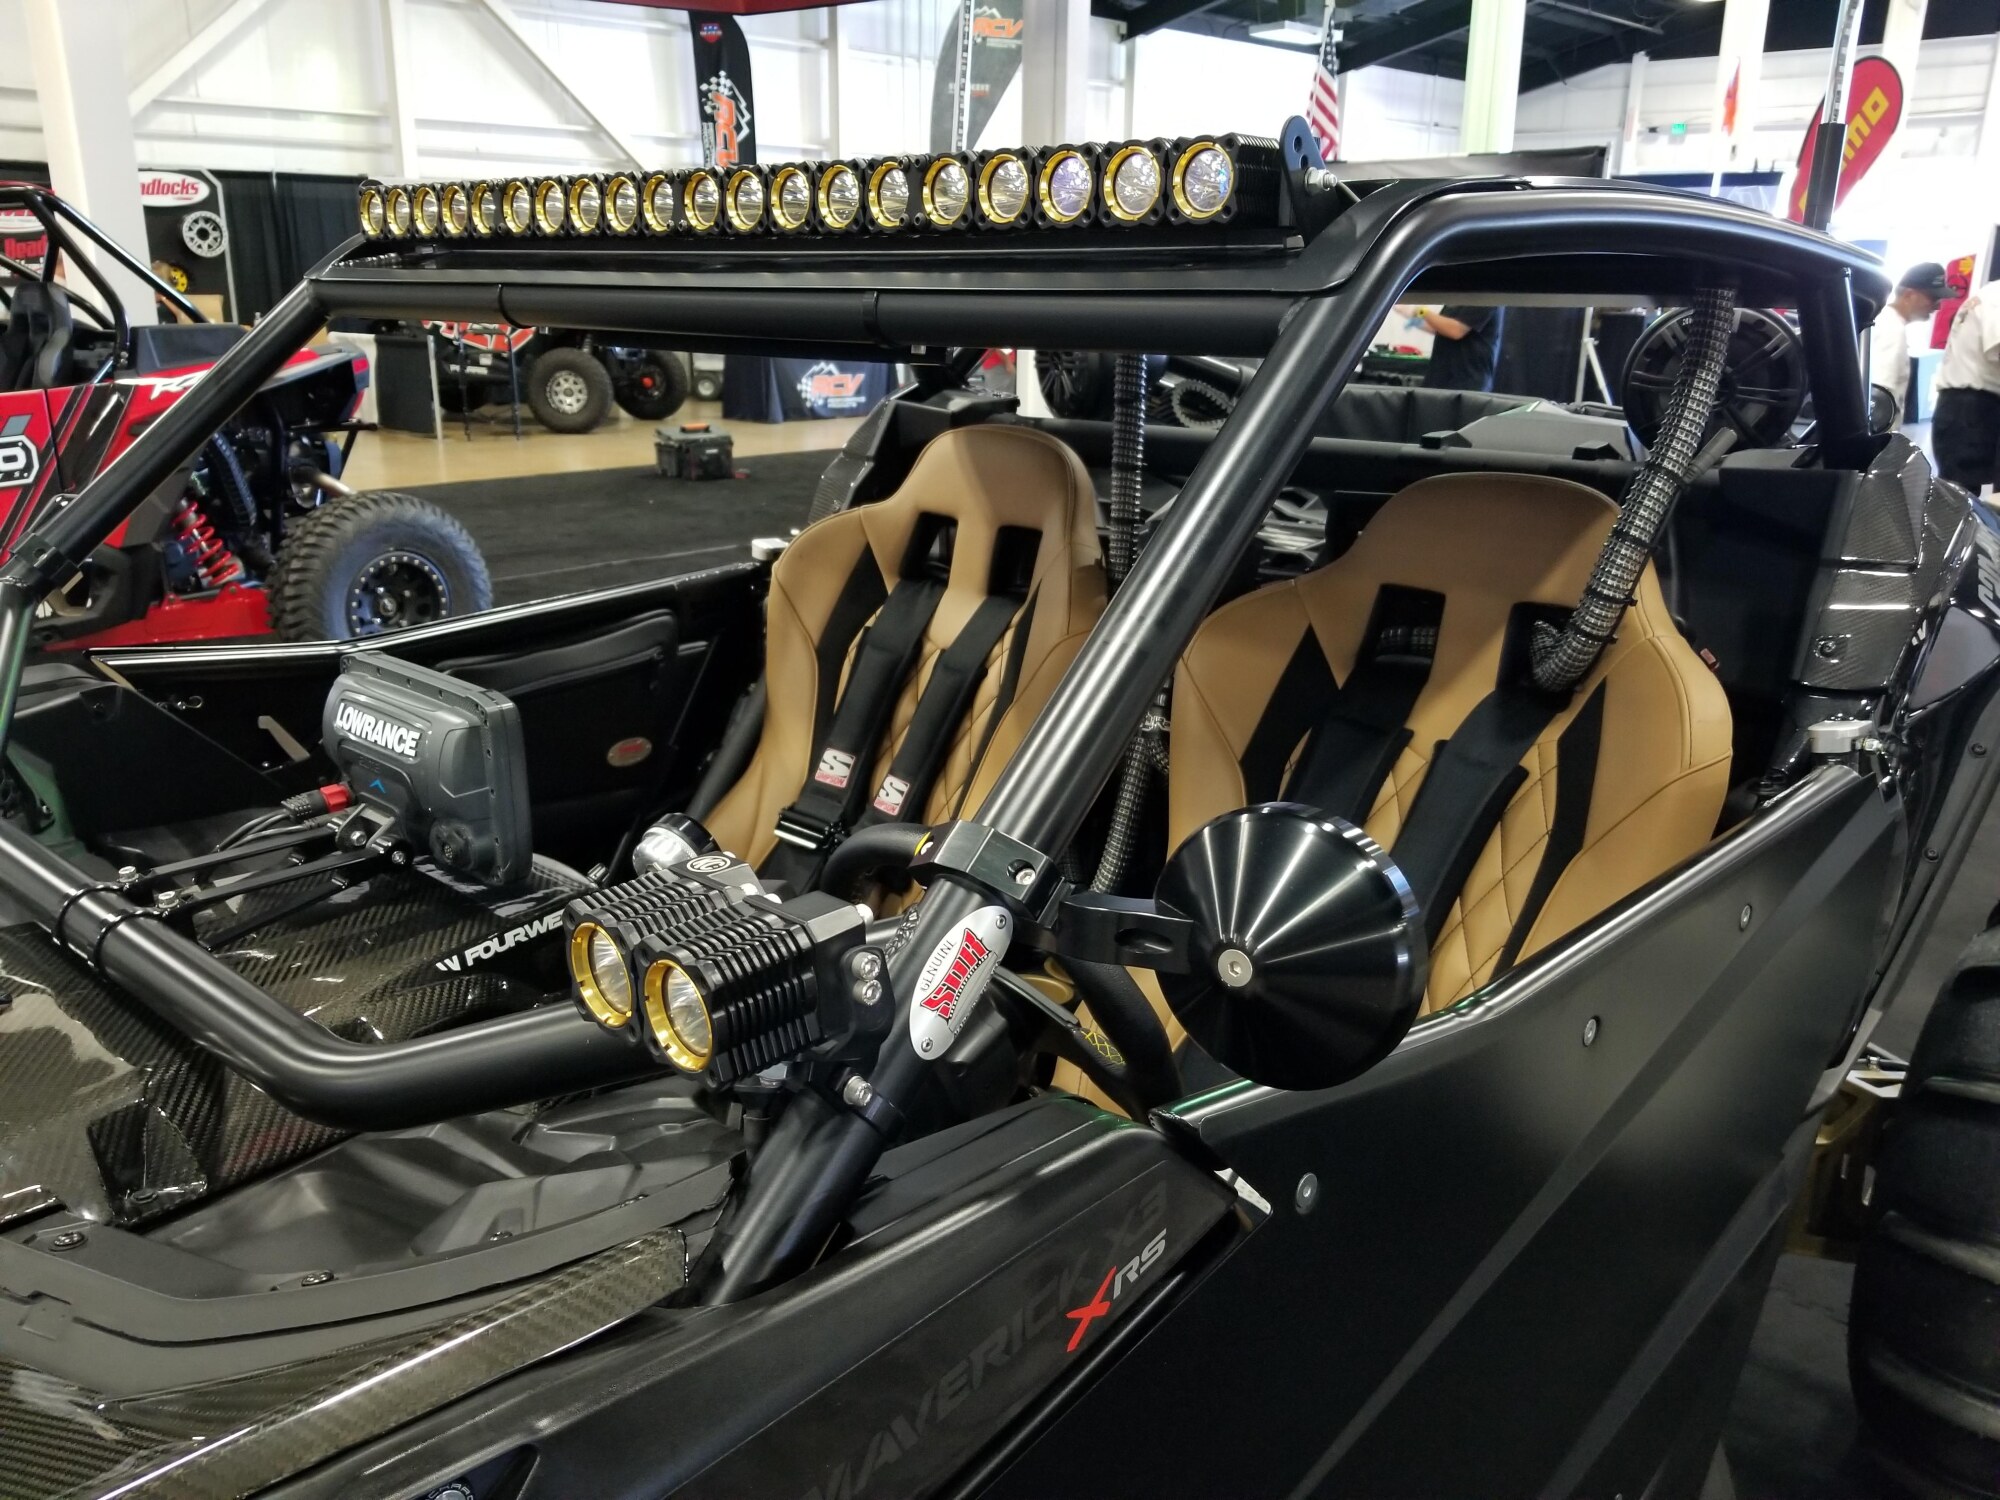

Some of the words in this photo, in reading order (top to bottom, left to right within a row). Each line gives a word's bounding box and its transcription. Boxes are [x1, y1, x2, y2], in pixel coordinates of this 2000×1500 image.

[811, 373, 866, 398] RCV
[335, 702, 421, 757] LOWRANCE
[919, 927, 991, 1020] SDR
